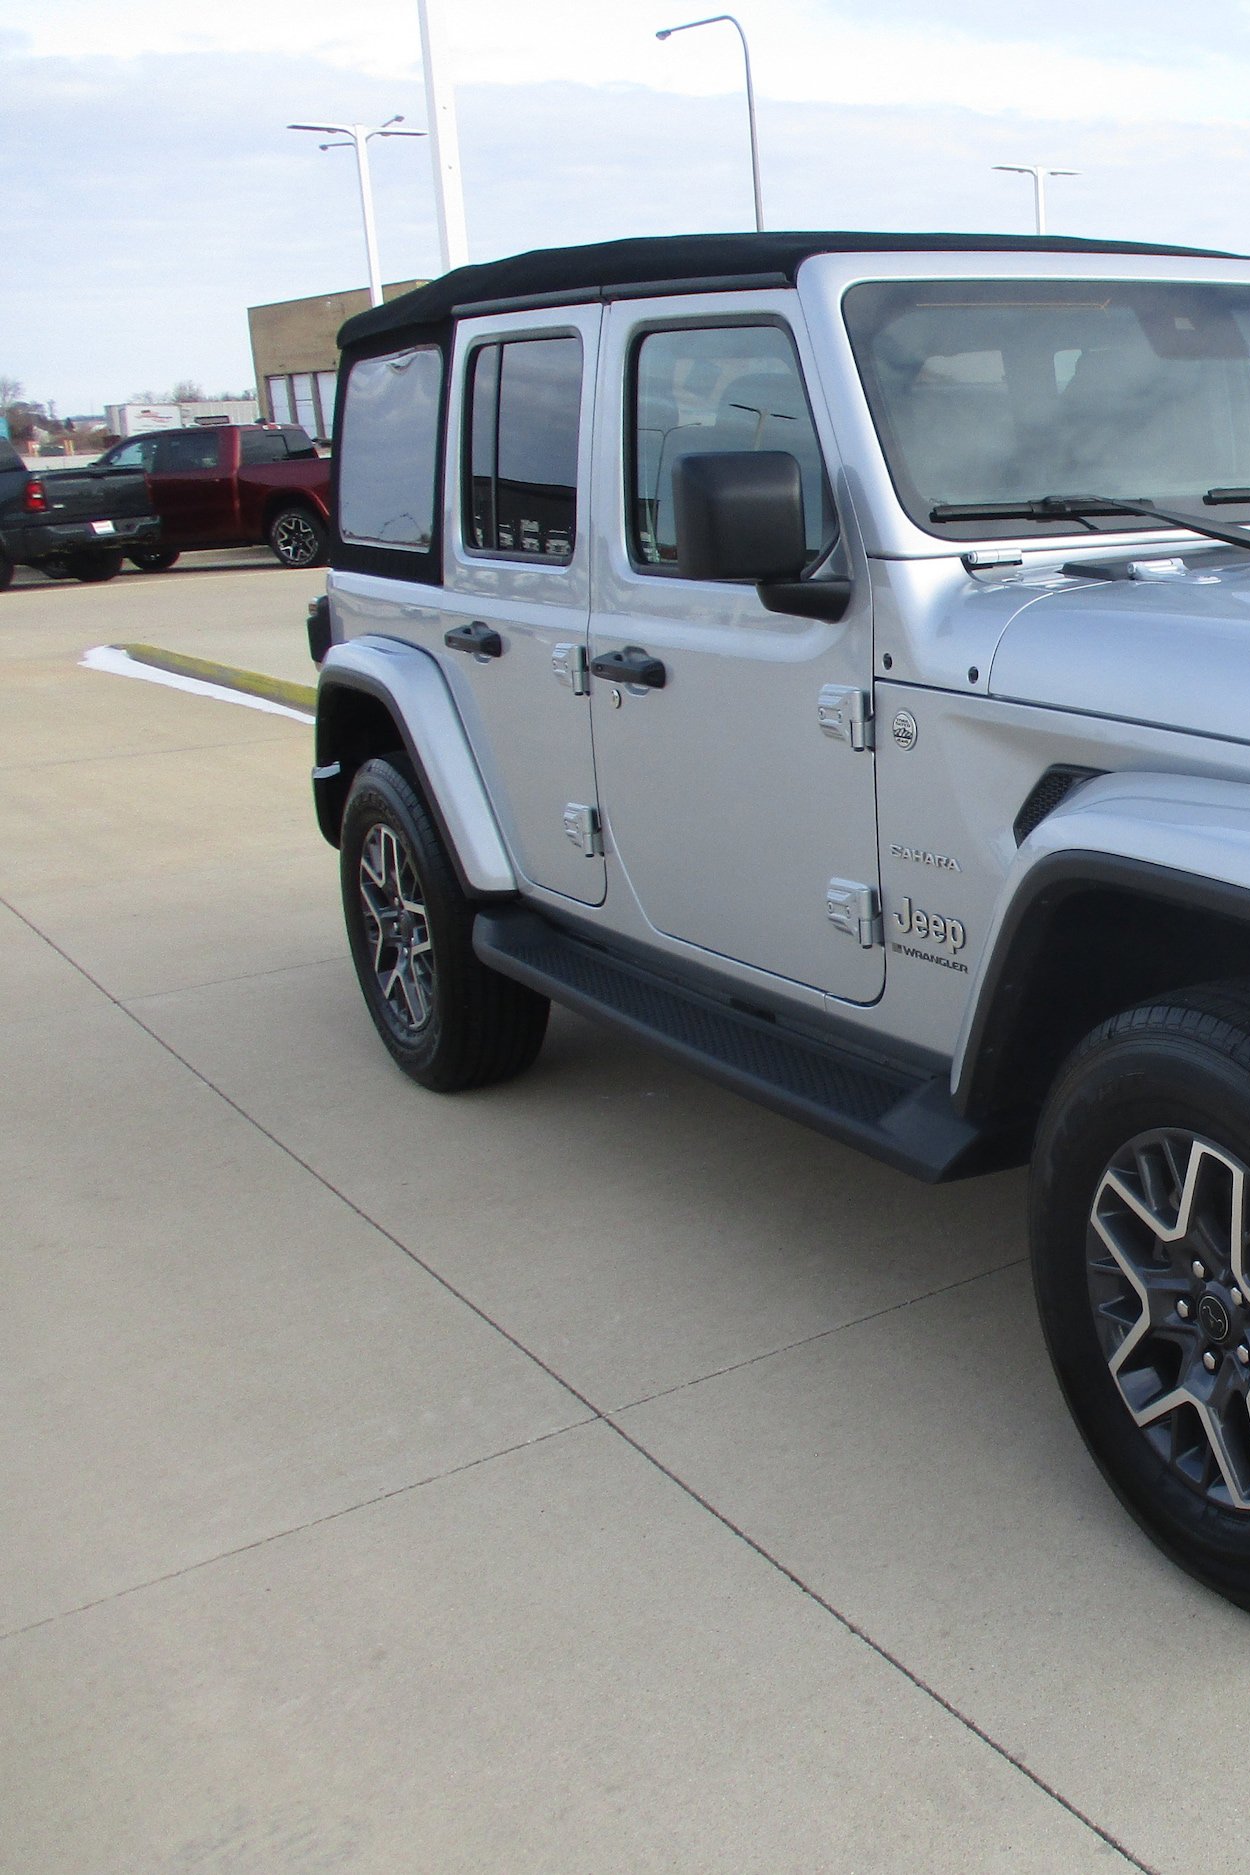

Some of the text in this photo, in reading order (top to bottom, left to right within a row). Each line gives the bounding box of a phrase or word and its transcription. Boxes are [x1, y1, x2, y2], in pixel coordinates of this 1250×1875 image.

[889, 843, 963, 872] SAHARA
[892, 896, 966, 955] Jeep
[902, 945, 969, 974] WRANGLER
